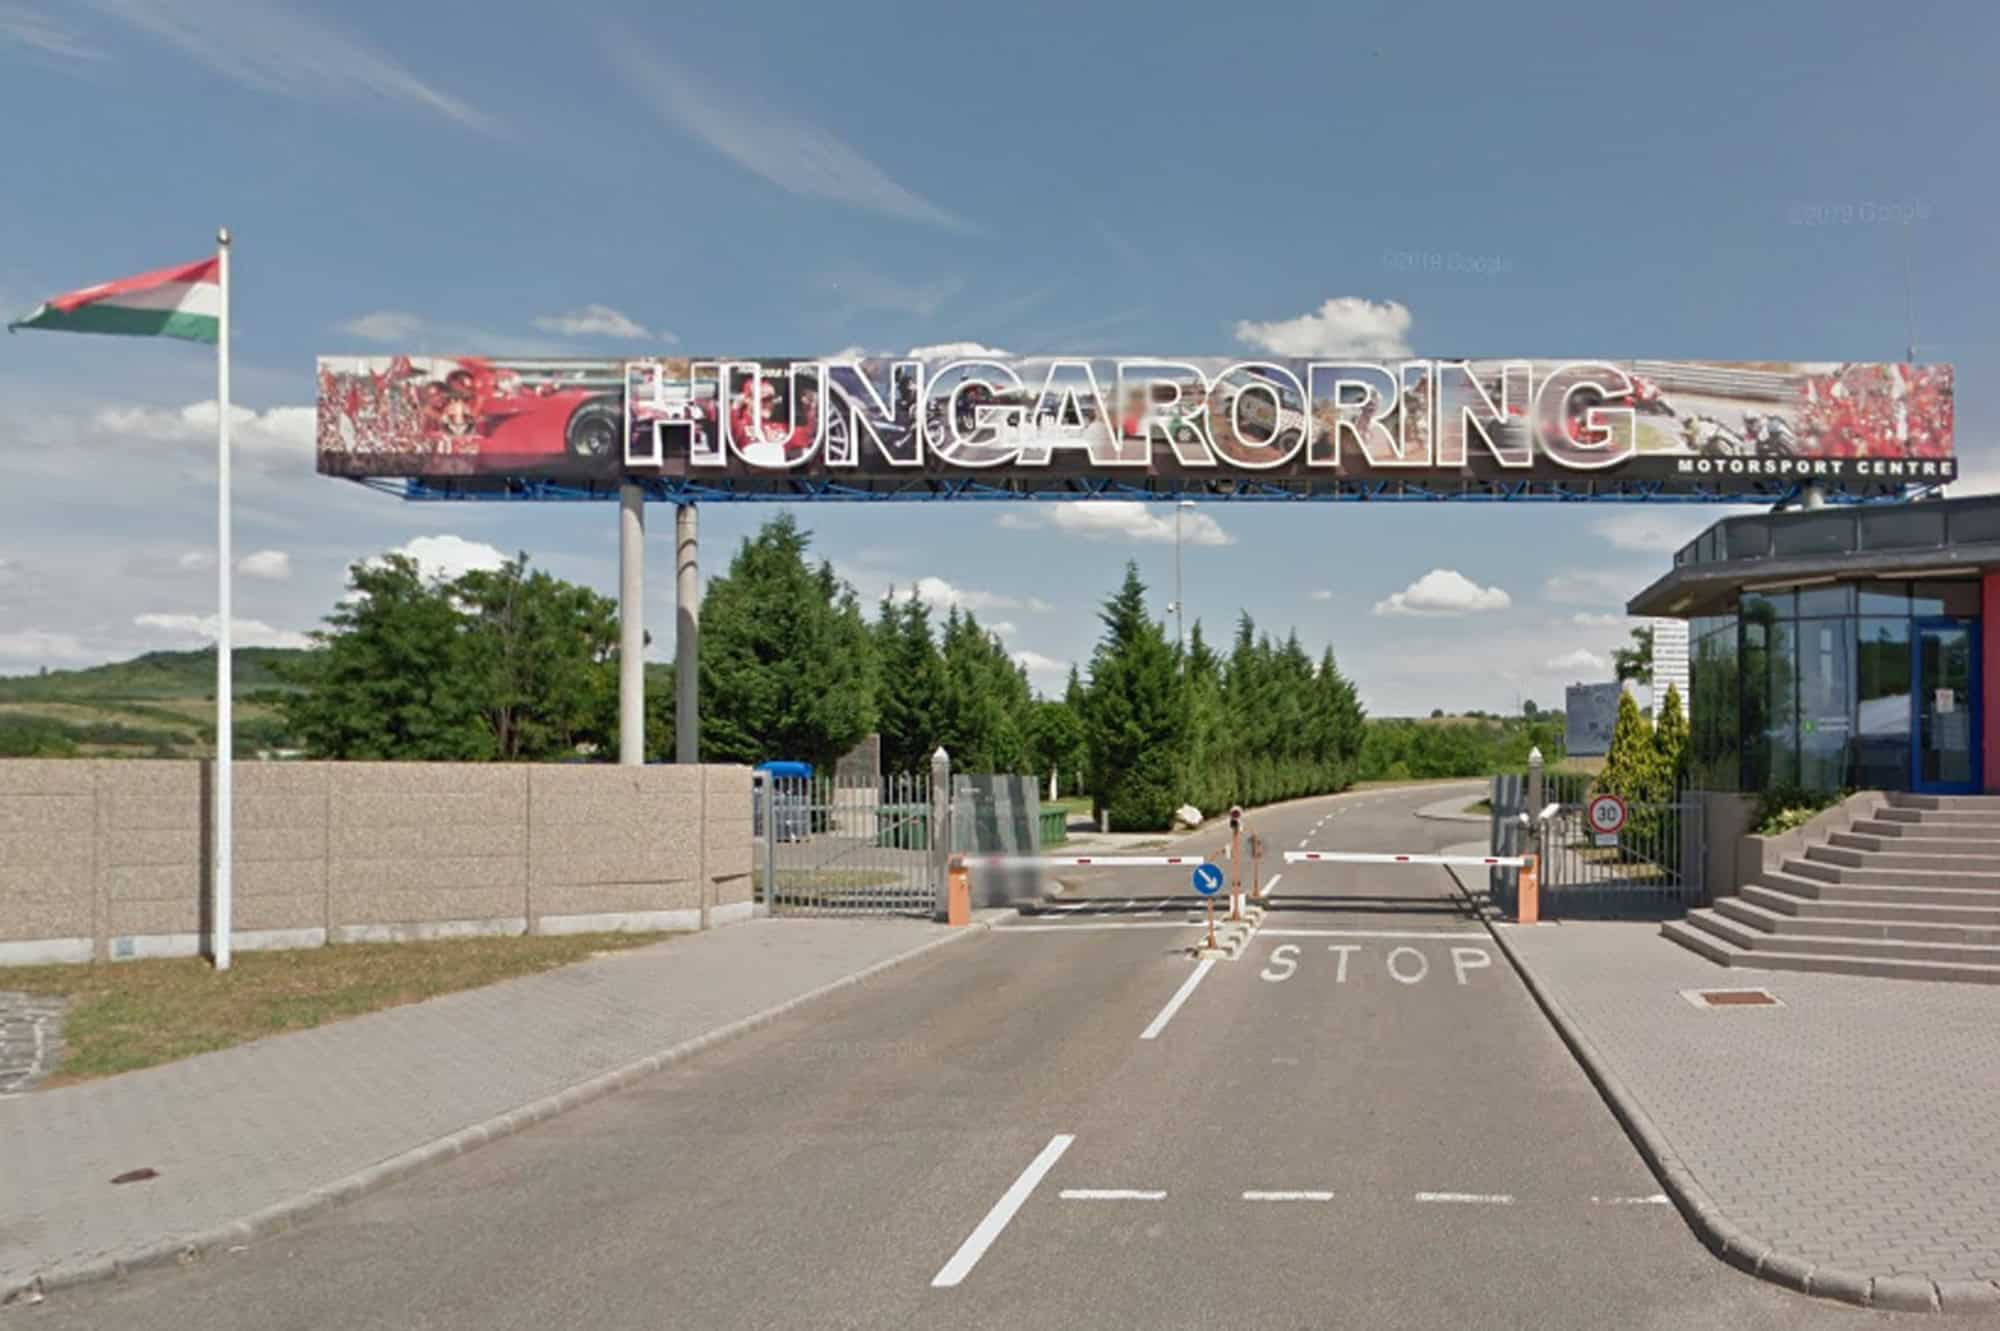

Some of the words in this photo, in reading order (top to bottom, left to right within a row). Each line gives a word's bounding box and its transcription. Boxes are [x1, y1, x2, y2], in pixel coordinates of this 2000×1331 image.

[624, 361, 1635, 469] HUNGARORING
[1678, 459, 1843, 474] MOTORSPORT
[1856, 460, 1953, 476] CENTRE
[1598, 806, 1617, 821] 30
[1260, 944, 1491, 985] STOP
